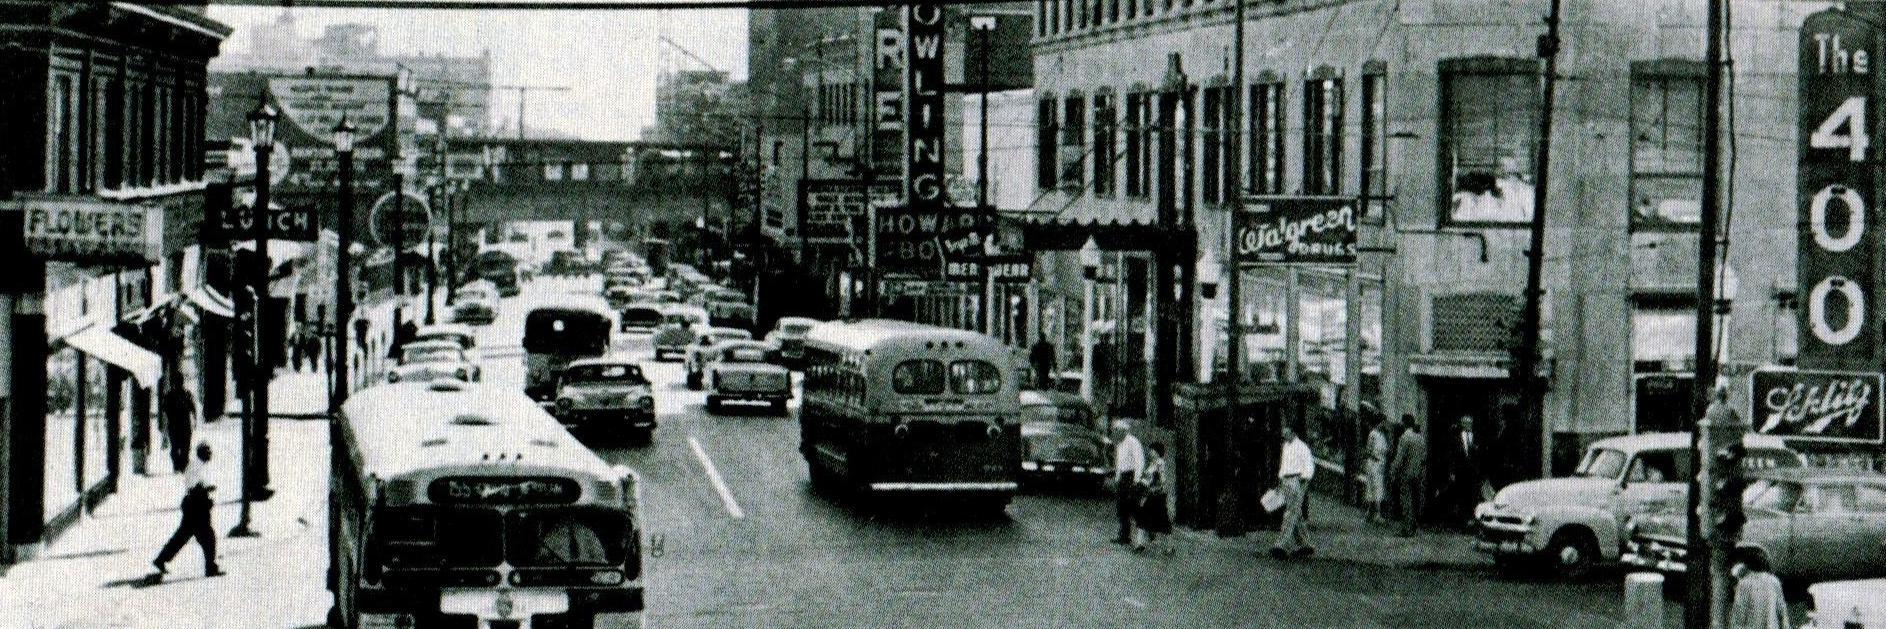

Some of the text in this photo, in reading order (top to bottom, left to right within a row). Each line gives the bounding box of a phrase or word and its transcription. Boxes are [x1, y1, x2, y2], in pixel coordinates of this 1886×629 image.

[1814, 33, 1869, 75] The
[28, 207, 143, 237] FLOWERS
[1239, 206, 1356, 254] Walgreen
[1810, 96, 1870, 346] 400
